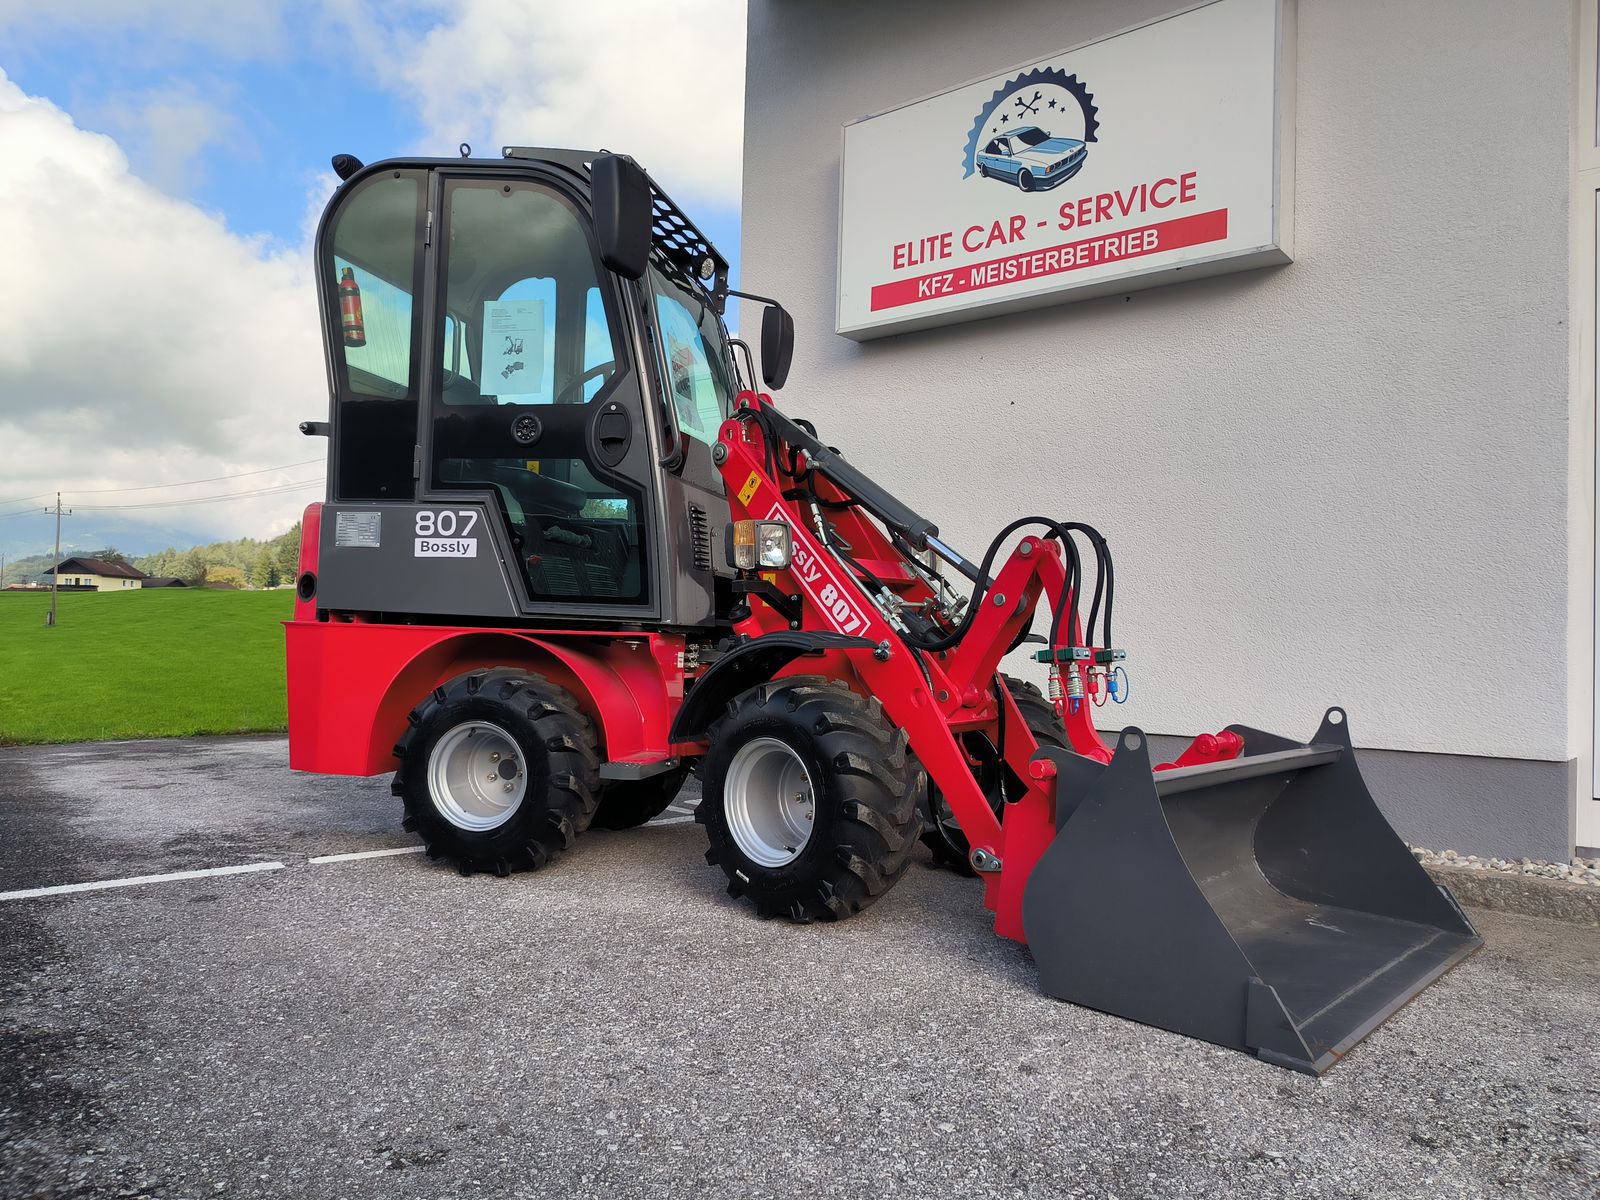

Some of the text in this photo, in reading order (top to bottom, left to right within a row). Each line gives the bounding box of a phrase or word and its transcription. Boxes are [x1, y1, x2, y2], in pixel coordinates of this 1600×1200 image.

[893, 232, 952, 270] ELITE
[961, 214, 1026, 253] CAR
[1058, 171, 1197, 231] SERVICE
[918, 274, 953, 298] KFZ
[970, 229, 1159, 287] MEISTERBETRIEB
[415, 510, 478, 536] 807
[420, 540, 471, 554] Bossly
[820, 584, 861, 633] 807
